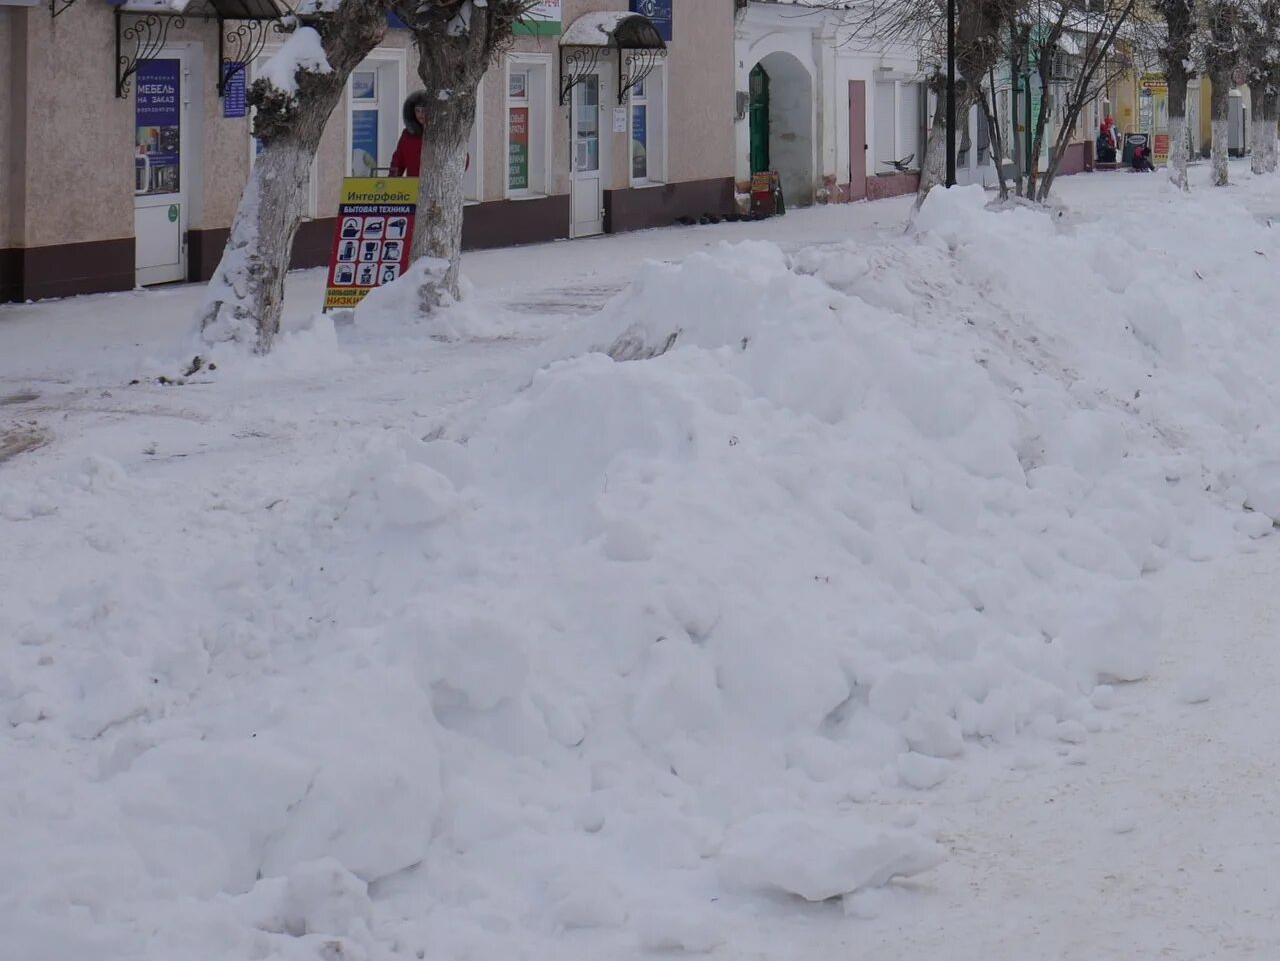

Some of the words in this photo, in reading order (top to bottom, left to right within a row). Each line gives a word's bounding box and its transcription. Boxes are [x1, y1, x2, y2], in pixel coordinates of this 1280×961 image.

[137, 84, 175, 94] МЕБЕЛЬ
[347, 191, 411, 203] Интерфейс
[343, 205, 378, 213] БЫТОВАЯ
[379, 205, 411, 213] ТЕХНИКА
